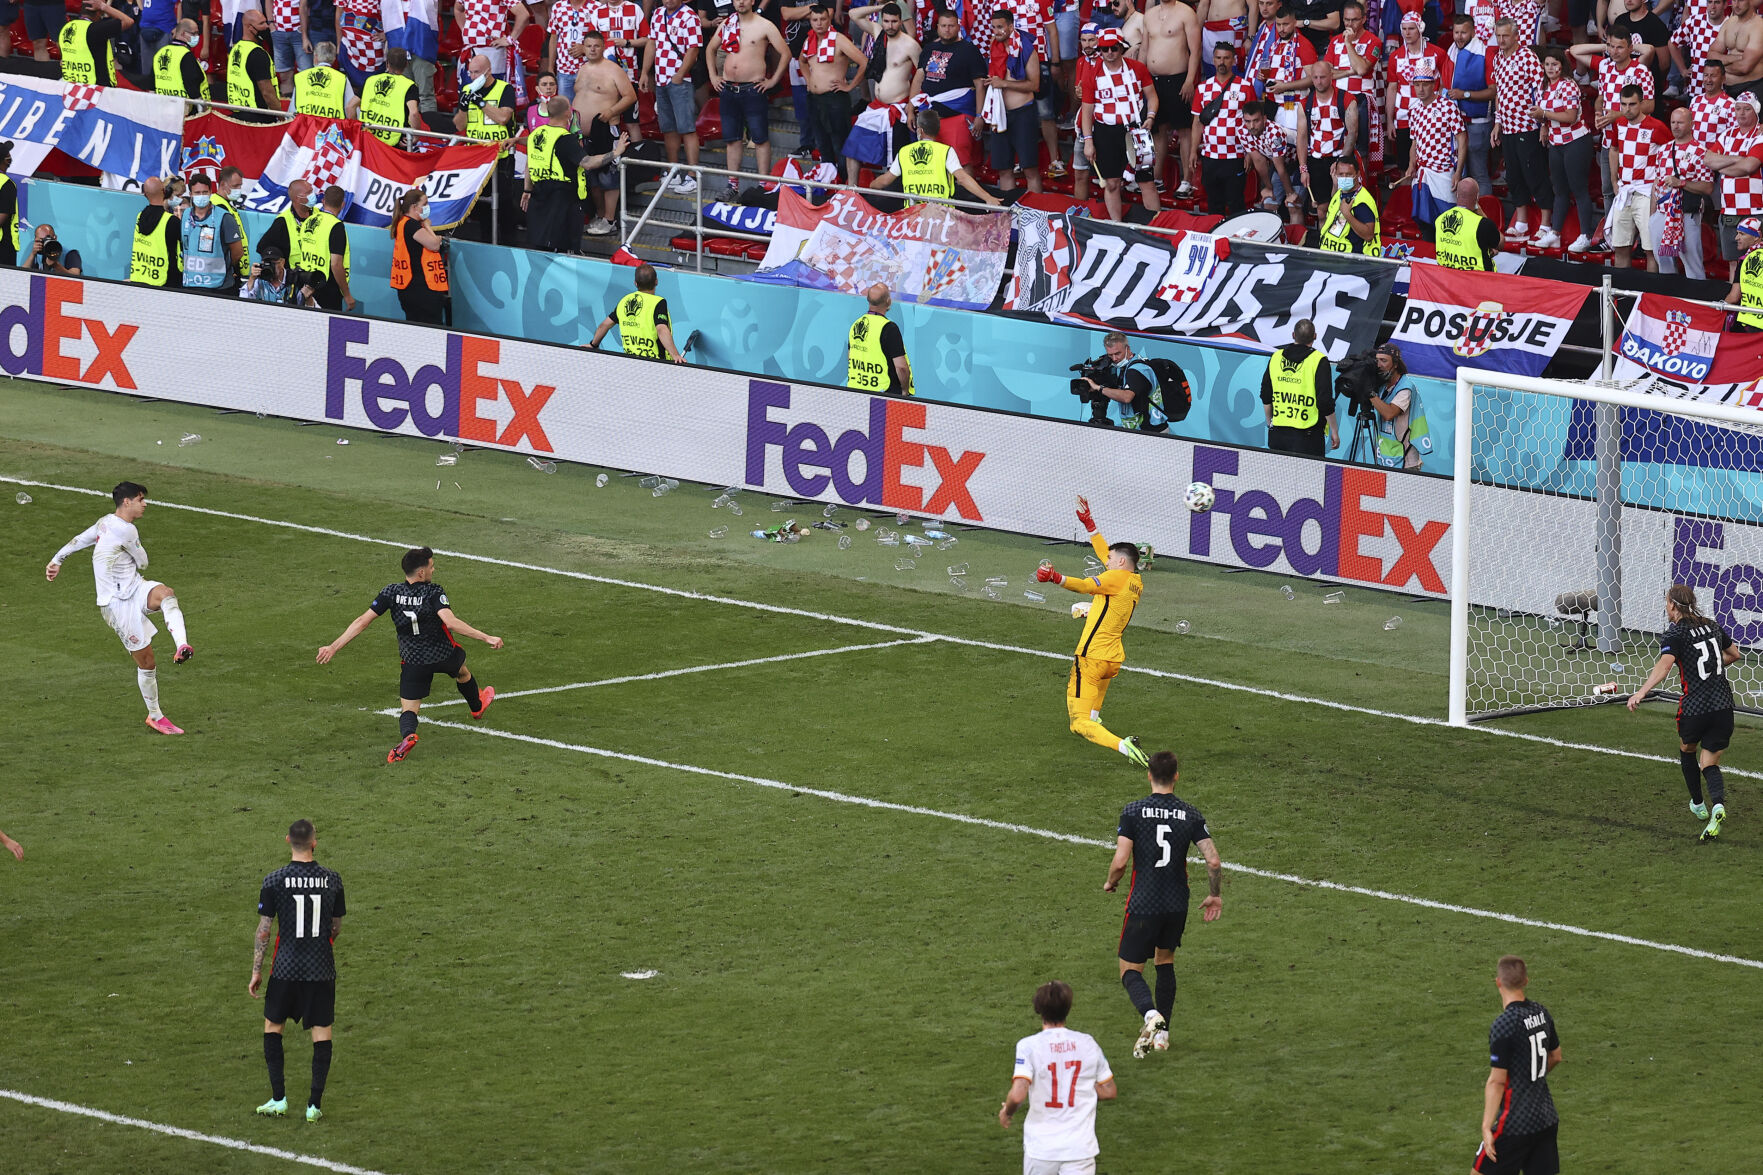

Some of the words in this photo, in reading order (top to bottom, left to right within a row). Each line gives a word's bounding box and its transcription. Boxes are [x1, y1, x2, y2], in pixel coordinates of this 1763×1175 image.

[1184, 244, 1209, 276] 94
[1400, 305, 1557, 348] POSUŠJE
[1622, 338, 1708, 380] ĐAKOVO
[324, 315, 557, 452] FedEx
[745, 379, 986, 522] FedEx
[1188, 445, 1452, 595] FedEx
[402, 610, 420, 635] 7
[1693, 637, 1722, 681] 21
[1154, 824, 1173, 868] 5
[292, 894, 321, 938] 11
[1528, 1030, 1547, 1082] 15
[1045, 1060, 1082, 1109] 17
